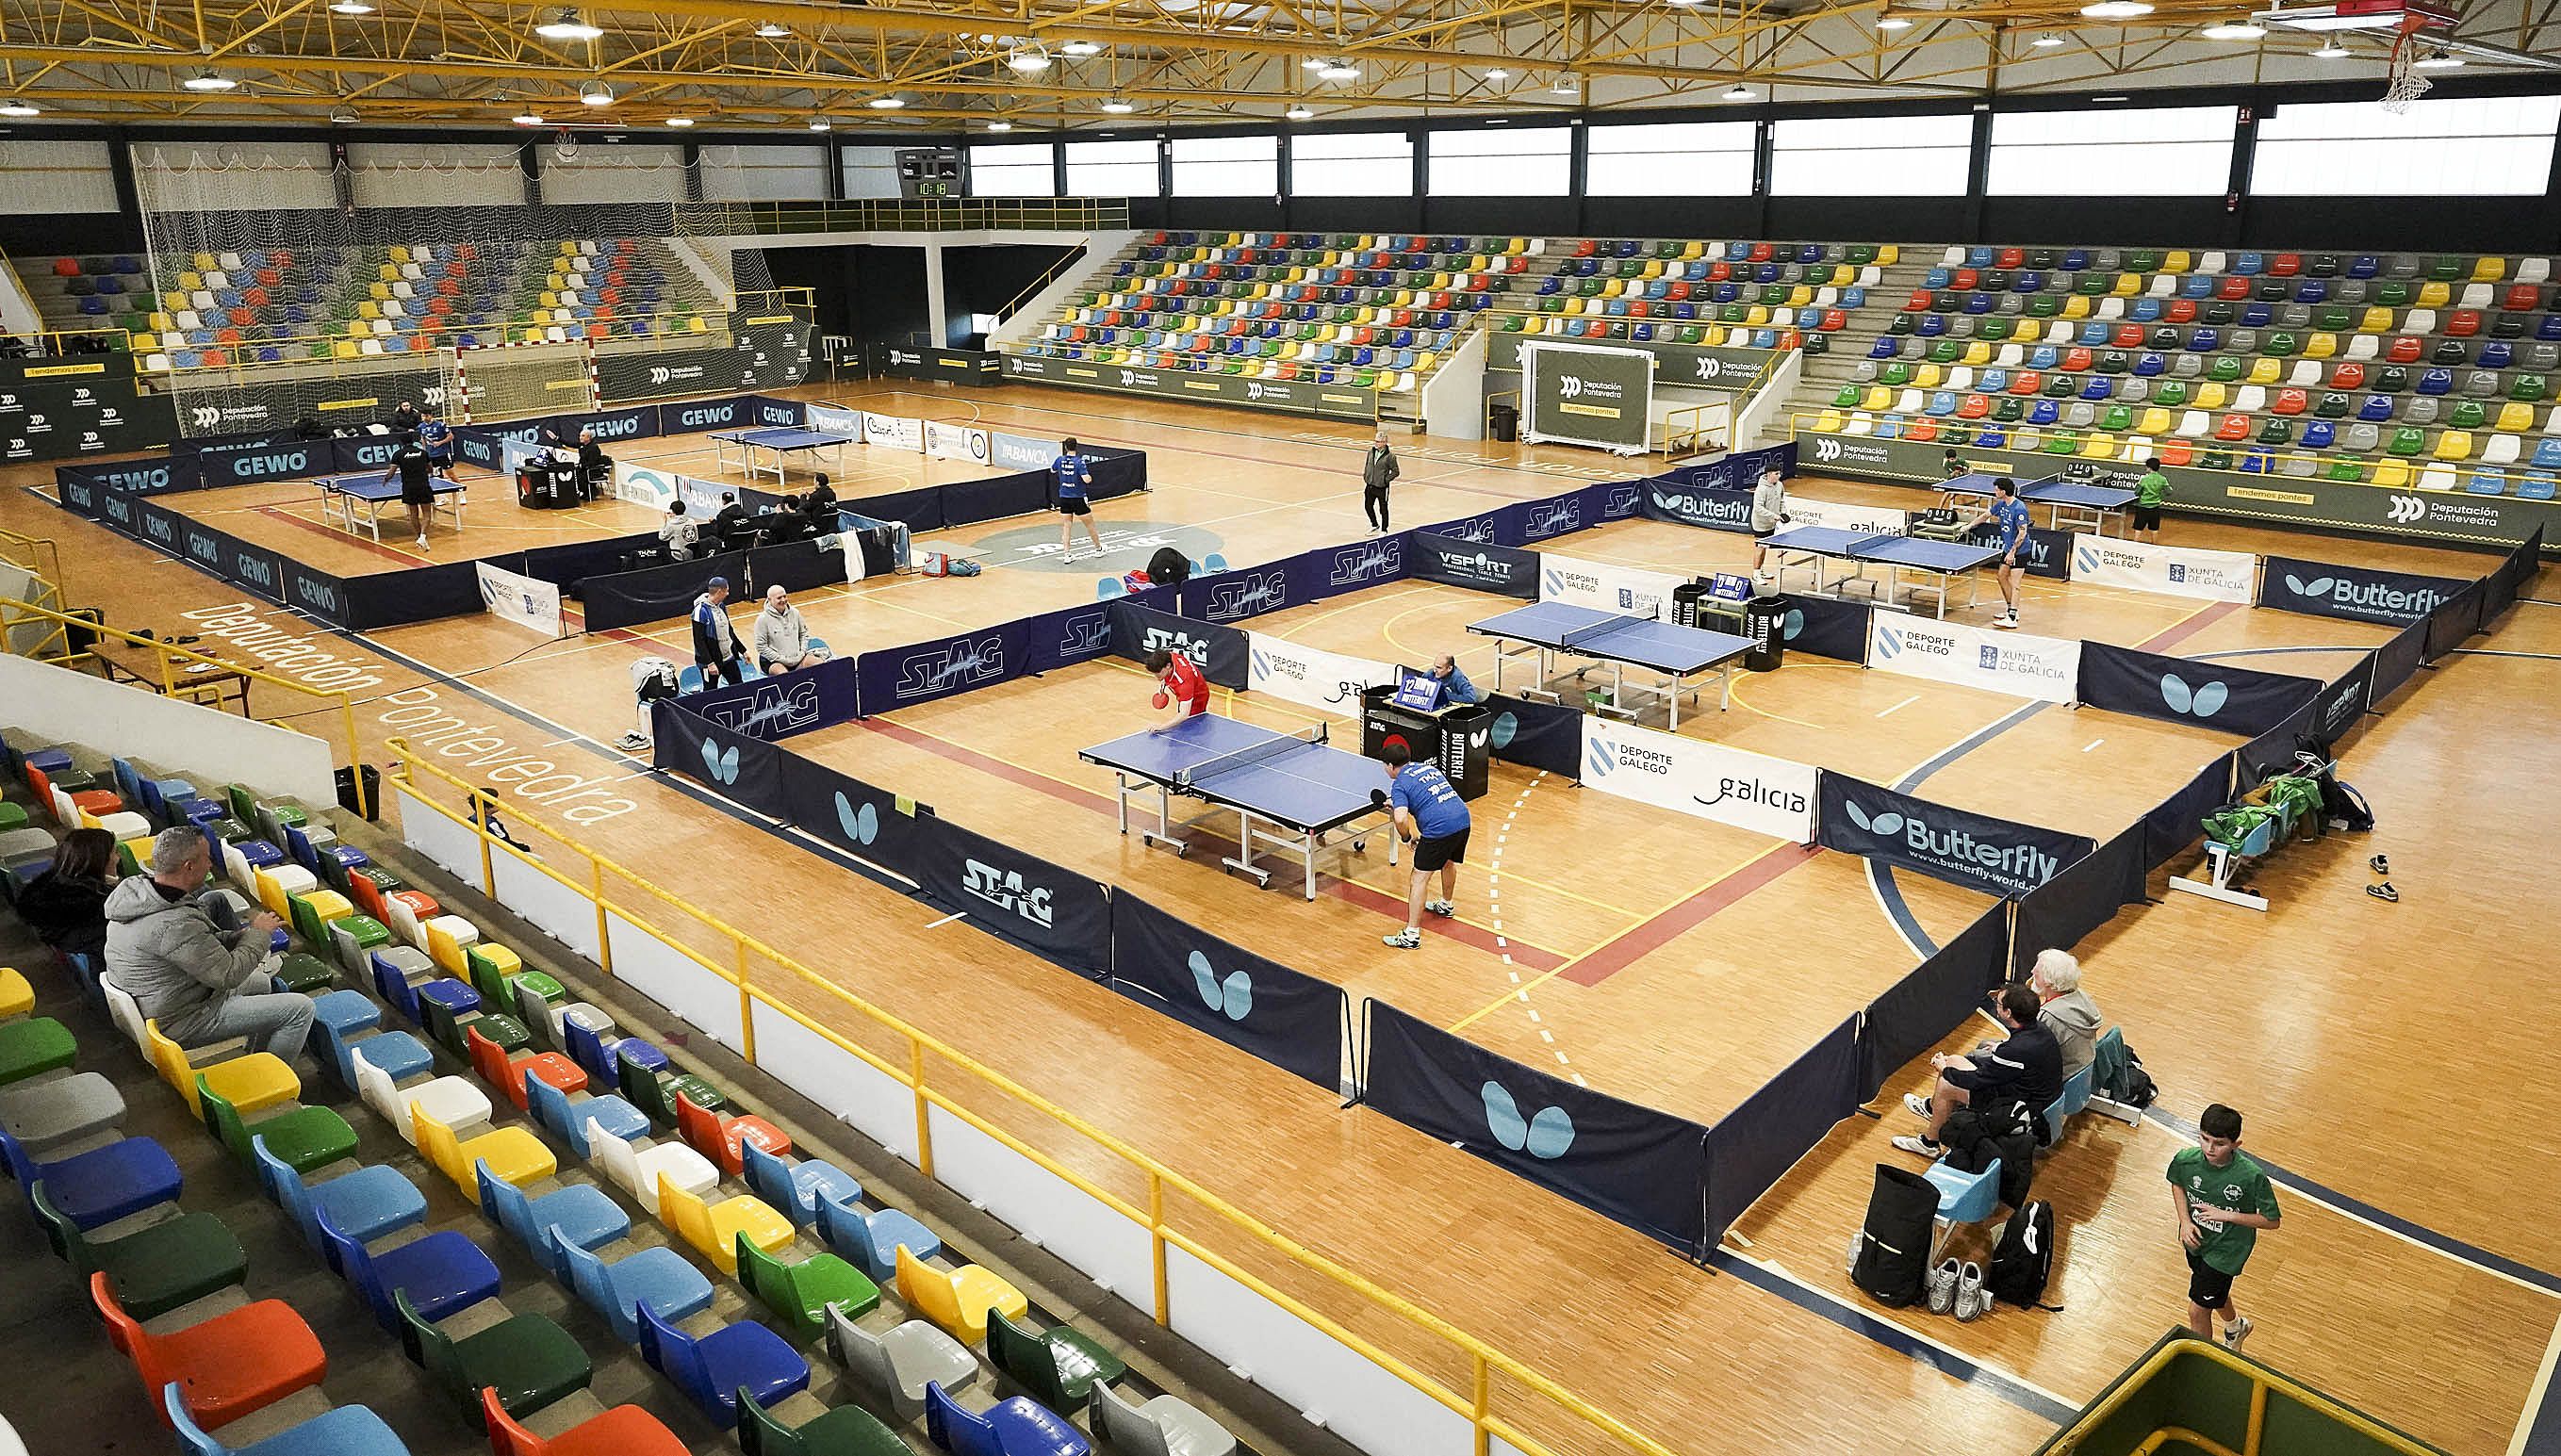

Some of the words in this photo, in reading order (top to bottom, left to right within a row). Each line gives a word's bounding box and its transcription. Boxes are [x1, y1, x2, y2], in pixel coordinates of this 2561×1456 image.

[919, 183, 945, 195] 10:18
[1722, 360, 1763, 371] Deputación
[1722, 368, 1763, 379] Pontevedra
[1584, 381, 1621, 392] Deputación
[1584, 387, 1621, 399] Pontevedra
[222, 404, 268, 416] Deputación
[223, 411, 269, 421] Pontevedra
[681, 406, 733, 426] GEWO
[763, 406, 795, 425] GEWO
[1596, 407, 1617, 417] pontes
[463, 439, 491, 462] GEWO
[1007, 445, 1049, 465] ABANCA
[1843, 451, 1888, 463] Pontevedra
[1844, 443, 1888, 456] Deputación
[234, 452, 307, 476] GEWO
[69, 483, 91, 508] GEWO
[2233, 487, 2275, 499] Tendemos
[2277, 492, 2307, 503] pontes
[106, 496, 128, 523] GEWO
[1526, 497, 1580, 538] STAG
[1682, 496, 1750, 520] Butterfly
[1789, 510, 1823, 519] DEPORTE
[2431, 501, 2499, 517] Deputación
[146, 513, 172, 543] GEWO
[2430, 512, 2498, 527] Pontevedra
[190, 532, 219, 564] GEWO
[2103, 550, 2145, 564] DEPORTE
[238, 553, 271, 585] GEWO
[1331, 539, 1401, 586] STAG
[1439, 551, 1512, 574] VSPORT
[2103, 557, 2142, 569] GALEGO
[2188, 566, 2224, 578] XUNTA
[1566, 572, 1600, 585] DEPORTE
[1567, 581, 1597, 593] GALEGO
[2188, 575, 2202, 583] DE
[2204, 577, 2244, 590] GALICIA
[297, 576, 336, 612] GEWO
[1207, 572, 1286, 624] STAG
[180, 602, 384, 692] Deputación
[1905, 642, 1949, 656] GALEGO
[1906, 630, 1956, 649] DEPORTE
[1272, 655, 1307, 673] DEPORTE
[2001, 648, 2042, 665] XUNTA
[896, 635, 1004, 700] STAG
[2000, 660, 2015, 672] DE
[2017, 663, 2066, 680] GALICIA
[701, 681, 819, 742] STAG
[379, 687, 639, 826] Pontevedra
[1451, 732, 1465, 780] BUTTERFLY
[1620, 744, 1673, 766] DEPORTE
[1619, 757, 1668, 776] GALEGO
[1694, 777, 1806, 814] galicia
[1906, 817, 2059, 888] Butterfly
[962, 858, 1053, 929] STAG
